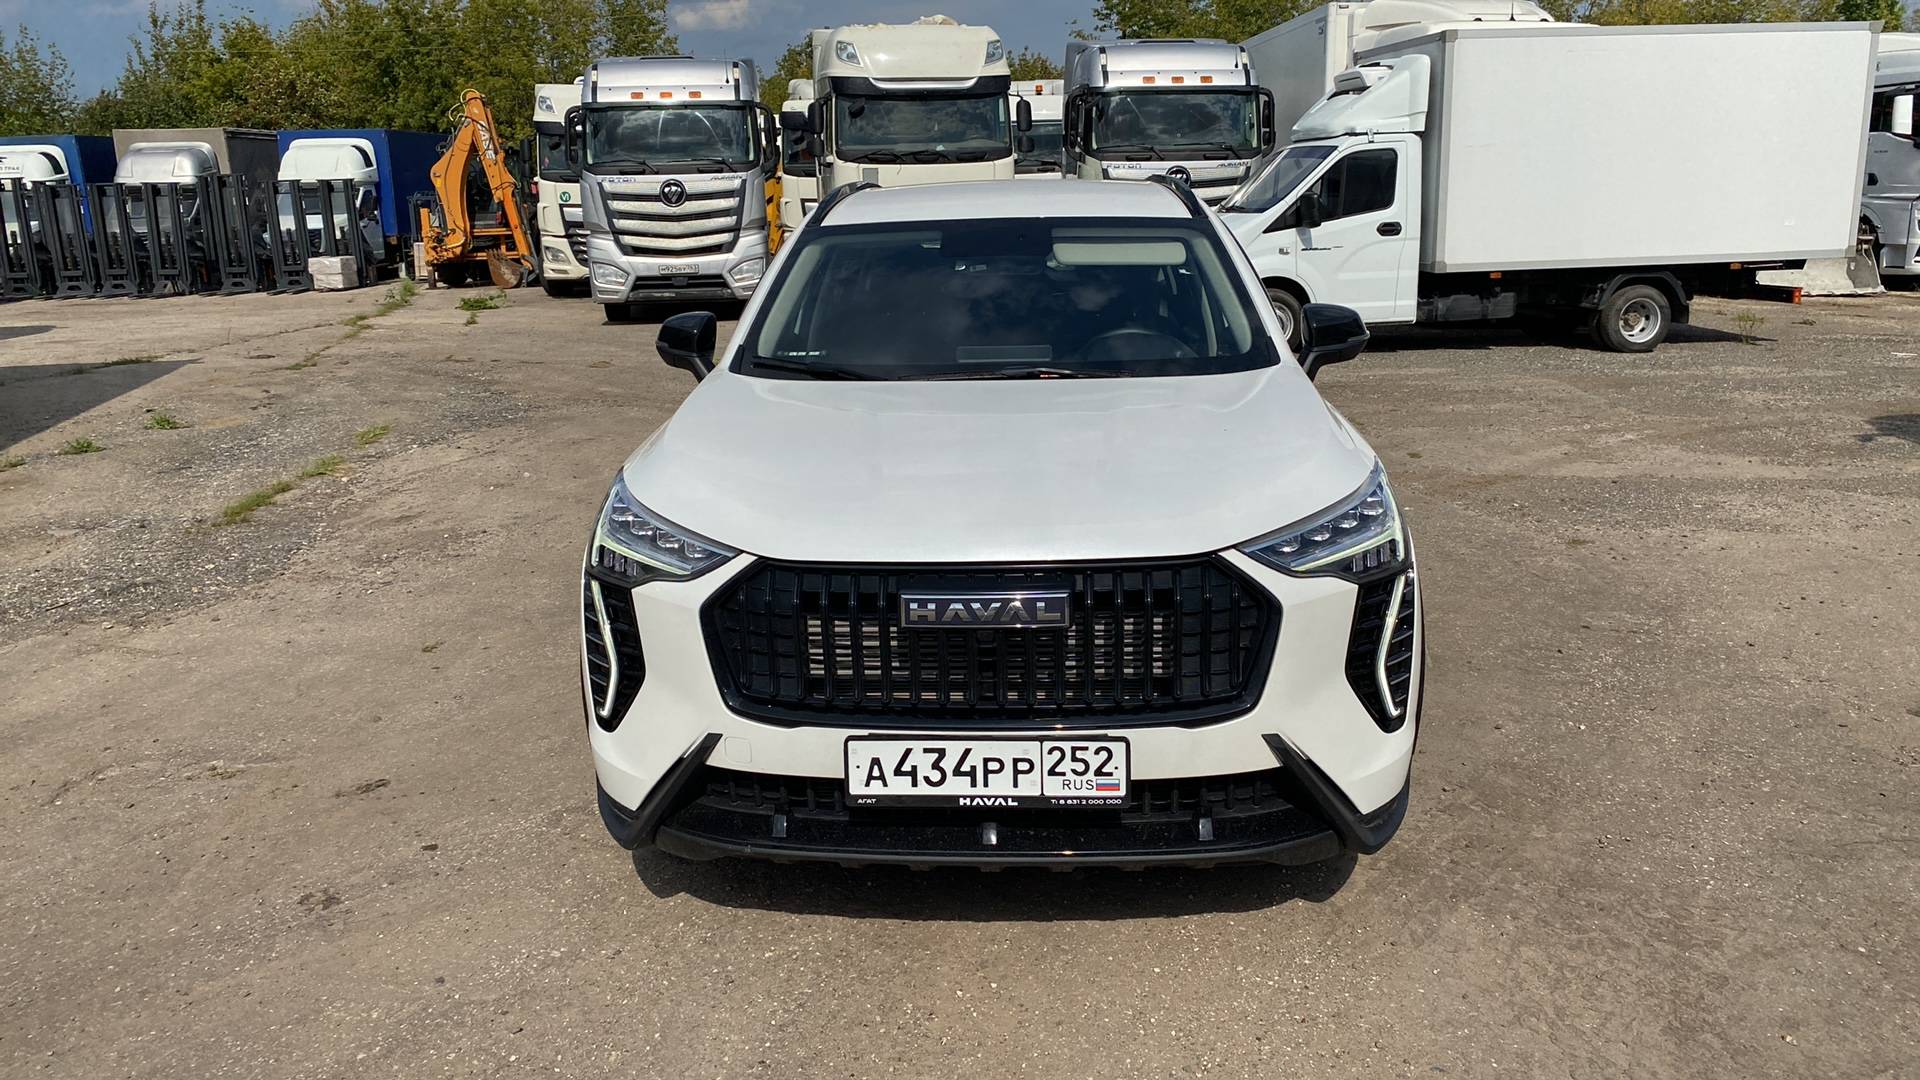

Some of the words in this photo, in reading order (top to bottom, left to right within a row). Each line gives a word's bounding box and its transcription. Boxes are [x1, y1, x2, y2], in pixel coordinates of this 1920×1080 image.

[909, 601, 1062, 622] HAVAL
[1047, 746, 1114, 777] 252
[1062, 778, 1095, 791] RUS
[959, 797, 1018, 806] HAVAL
